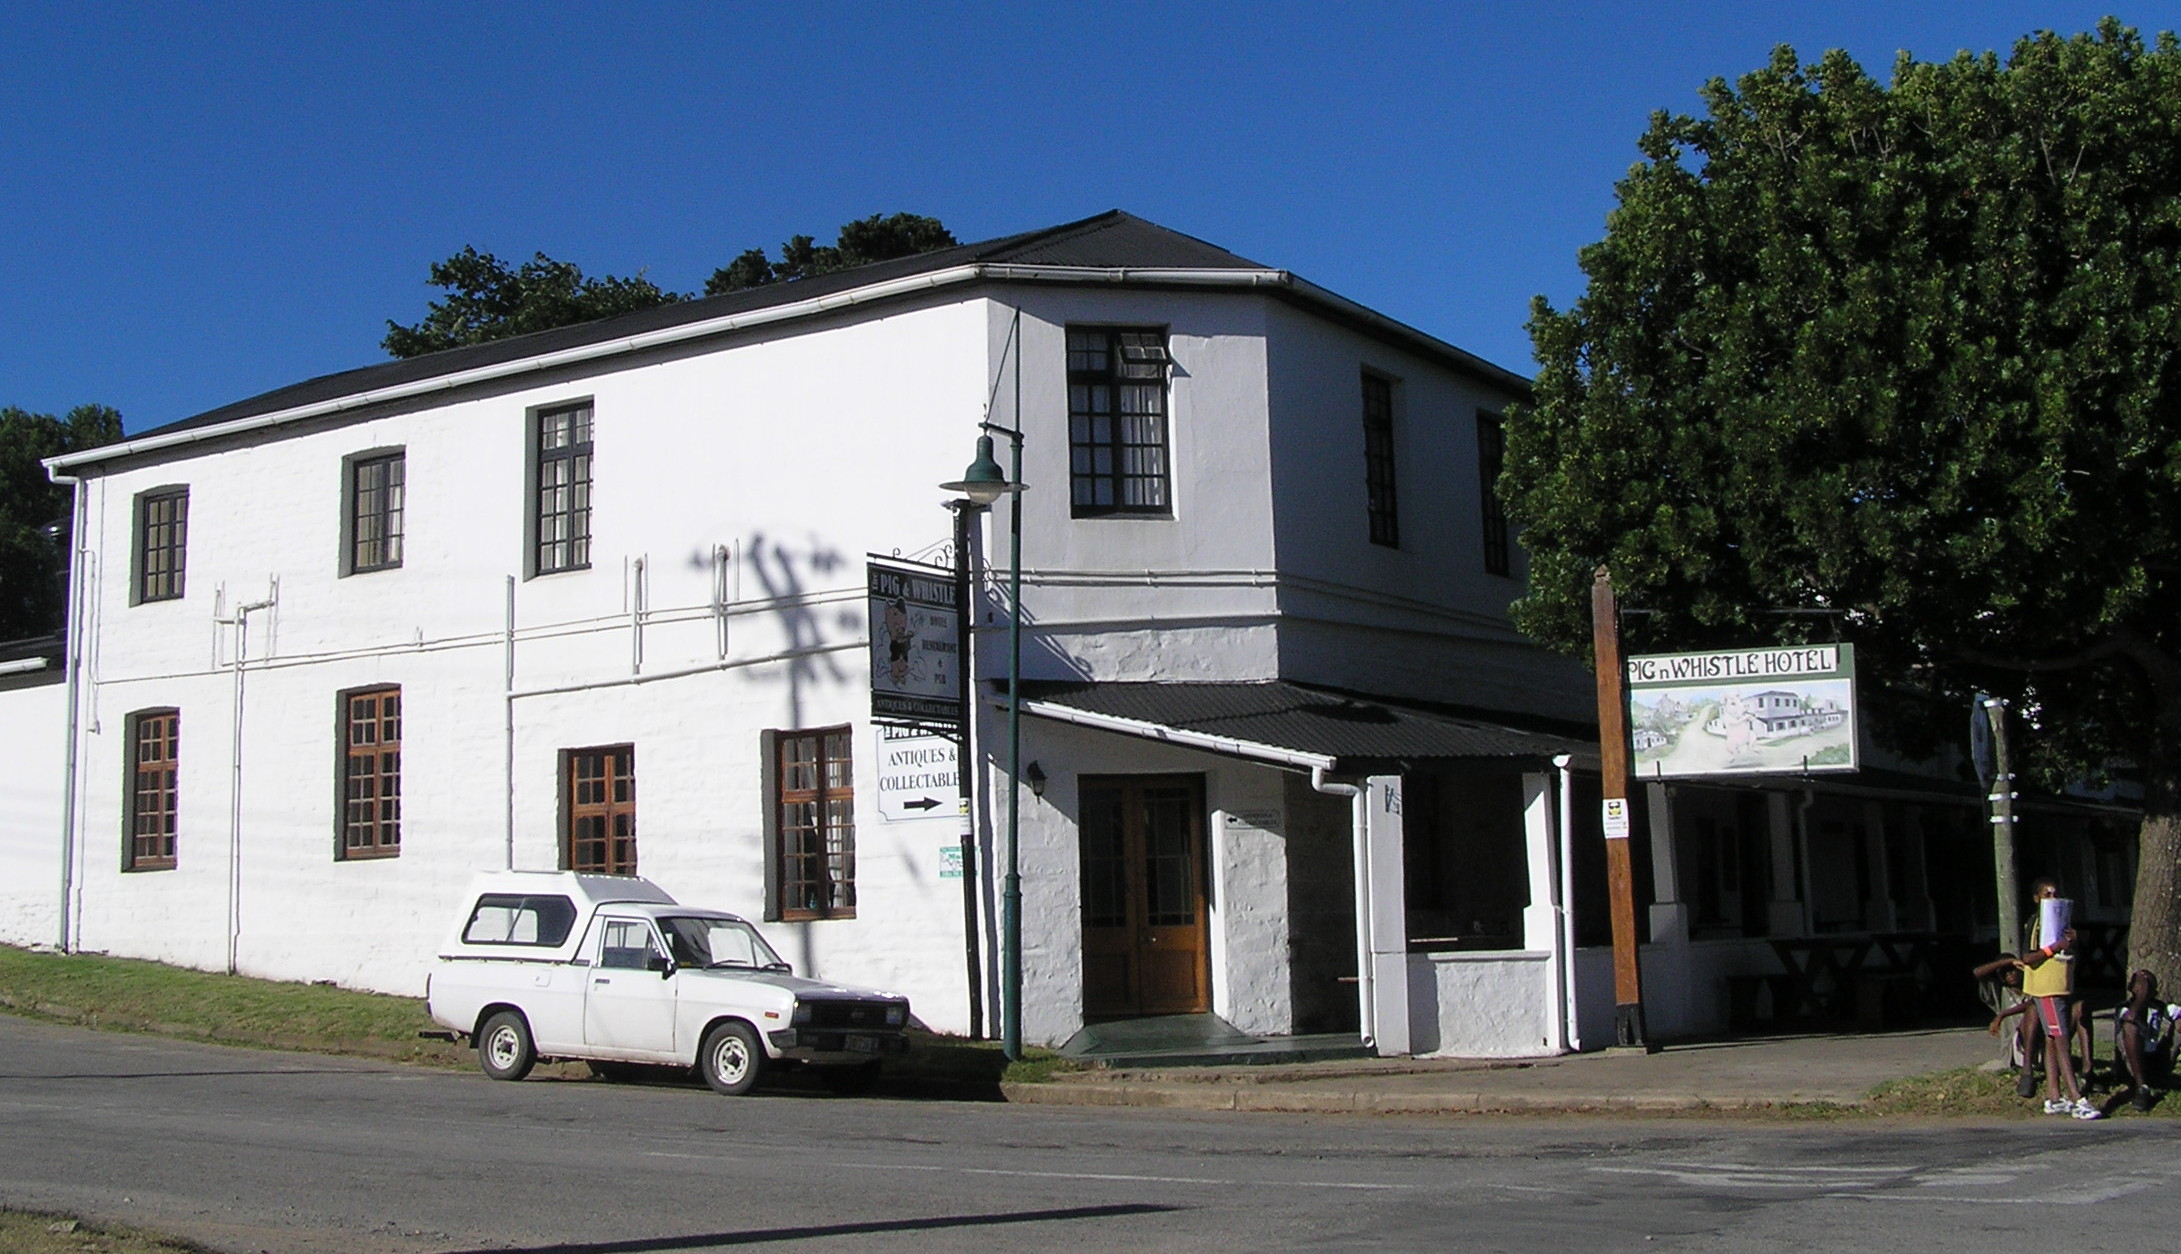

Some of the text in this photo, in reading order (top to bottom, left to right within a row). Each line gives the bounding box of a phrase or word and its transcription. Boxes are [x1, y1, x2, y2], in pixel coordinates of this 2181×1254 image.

[880, 574, 899, 596] PIG
[903, 582, 910, 597] &
[912, 578, 957, 606] WHISTLE
[1628, 649, 1832, 682] PIG n WHISTLE HOTEL
[888, 747, 956, 768] ANTIQUES &
[880, 772, 960, 792] COLLECTABLE
